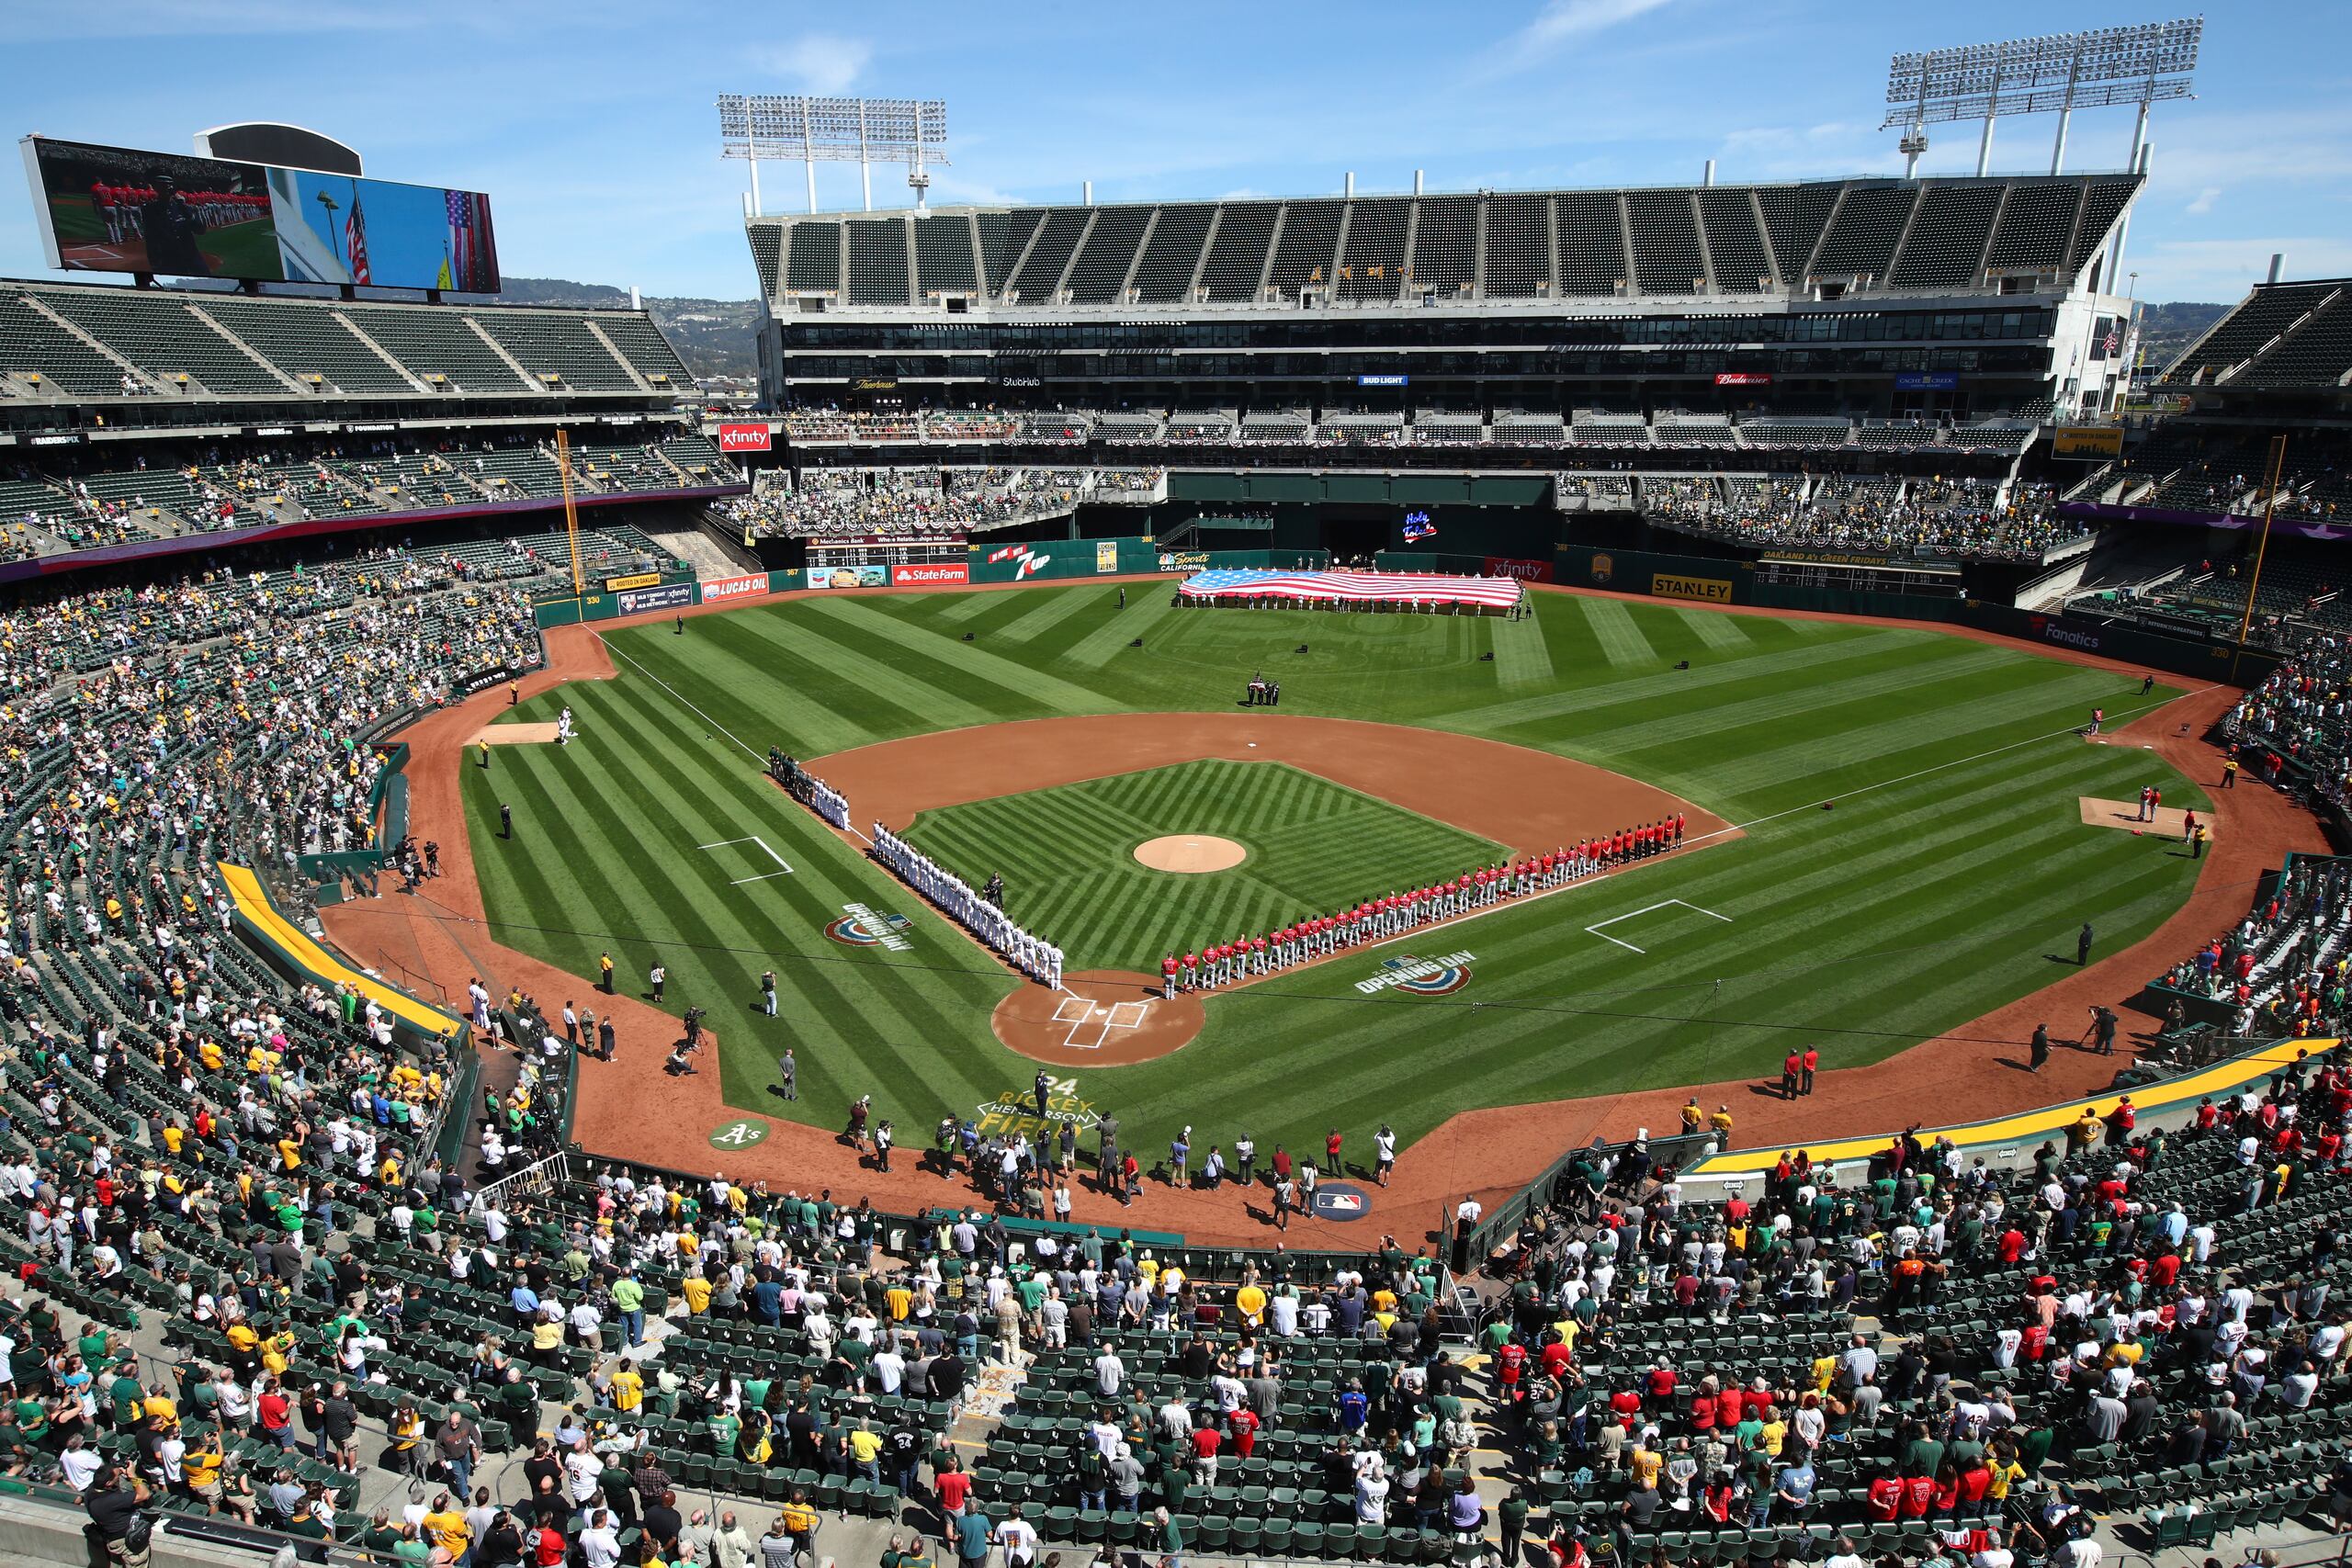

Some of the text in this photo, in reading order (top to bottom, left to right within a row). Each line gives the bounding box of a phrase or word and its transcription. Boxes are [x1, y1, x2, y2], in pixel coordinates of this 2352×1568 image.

[852, 378, 898, 390] Treehouse
[1002, 377, 1041, 388] StubHub
[1717, 374, 1769, 385] Budweiser
[354, 424, 395, 433] FOUNDATION
[30, 434, 80, 446] #RAIDERSPIX
[722, 429, 767, 446] xfinity
[1405, 511, 1430, 525] Holy
[1402, 523, 1438, 538] Toledo
[967, 544, 980, 552] 362
[1173, 552, 1210, 565] Sports
[1763, 551, 1887, 567] OAKLAND A's GREEN FRIDAYS
[1098, 562, 1116, 570] FIELD
[1494, 559, 1543, 580] xfinity
[1741, 561, 1756, 570] 362
[616, 579, 634, 587] ROOTED
[639, 576, 659, 585] OAKLAND
[720, 579, 751, 595] LUCAS
[752, 577, 766, 590] OIL
[669, 588, 690, 599] xfinity
[1655, 579, 1728, 598] STANLEY
[585, 595, 600, 604] 330
[647, 591, 667, 599] TONIGHT
[647, 600, 669, 608] NETWORK
[2045, 623, 2099, 649] Fanatics
[2211, 648, 2229, 659] 330
[842, 902, 915, 952] OPENING DAY
[1353, 949, 1477, 994] OPENING DAY
[990, 1103, 1091, 1123] HENRSON
[712, 1123, 762, 1145] A's
[681, 1204, 692, 1213] 24
[1845, 1207, 1854, 1216] 16
[860, 1213, 868, 1223] 10
[1899, 1236, 1914, 1247] 42
[1712, 1251, 1724, 1260] 24
[2032, 1336, 2048, 1348] 27
[2230, 1332, 2245, 1342] 27
[2006, 1341, 2015, 1351] 5
[1505, 1358, 1521, 1369] 27
[1404, 1379, 1410, 1390] 5
[1527, 1382, 1548, 1392] CHAPMA
[1225, 1390, 1233, 1400] 7
[1968, 1415, 1984, 1426] 42
[710, 1429, 729, 1440] 34
[898, 1438, 911, 1450] 24
[569, 1469, 581, 1482] 16
[1994, 1470, 2008, 1483] 21
